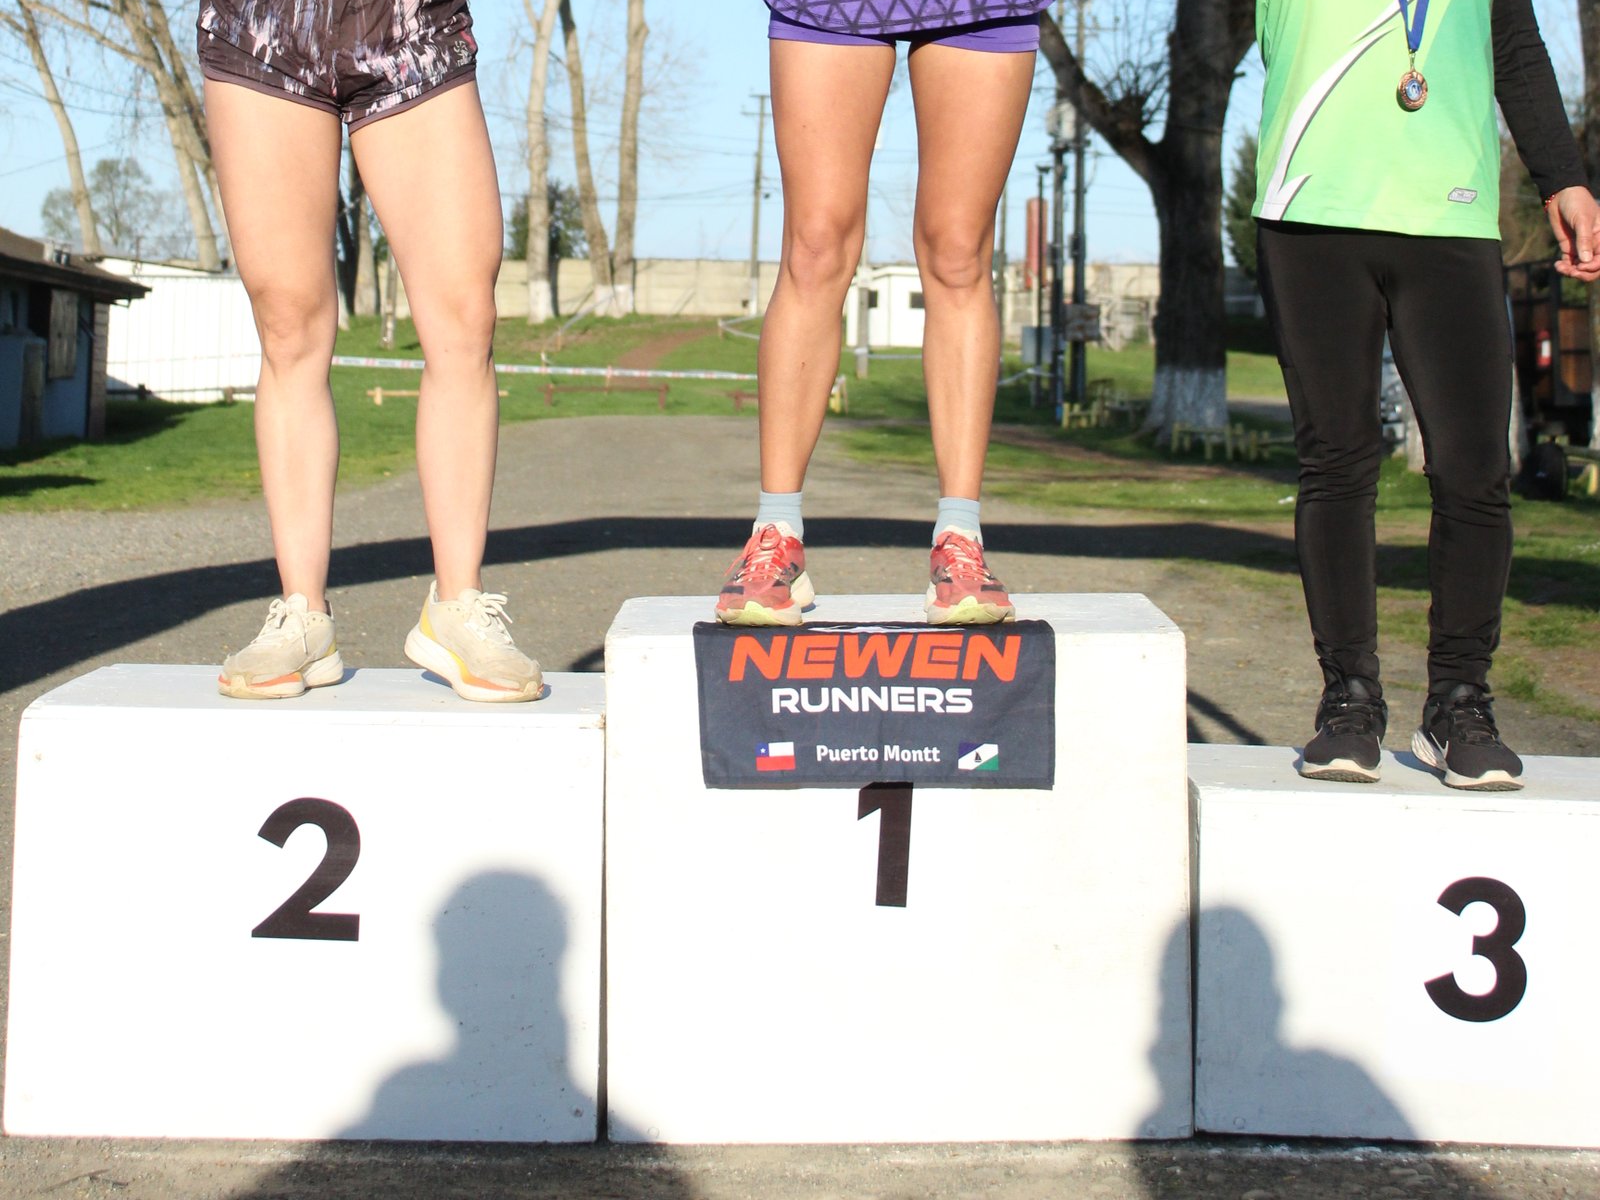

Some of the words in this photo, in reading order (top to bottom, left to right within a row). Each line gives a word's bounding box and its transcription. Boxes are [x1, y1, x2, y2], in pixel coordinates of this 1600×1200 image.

[729, 634, 1022, 682] NEWEN
[772, 686, 973, 714] RUNNERS
[816, 744, 879, 763] Puerto
[883, 745, 941, 763] Montt
[251, 797, 361, 942] 2
[857, 781, 914, 908] 1
[1424, 876, 1528, 1023] 3
